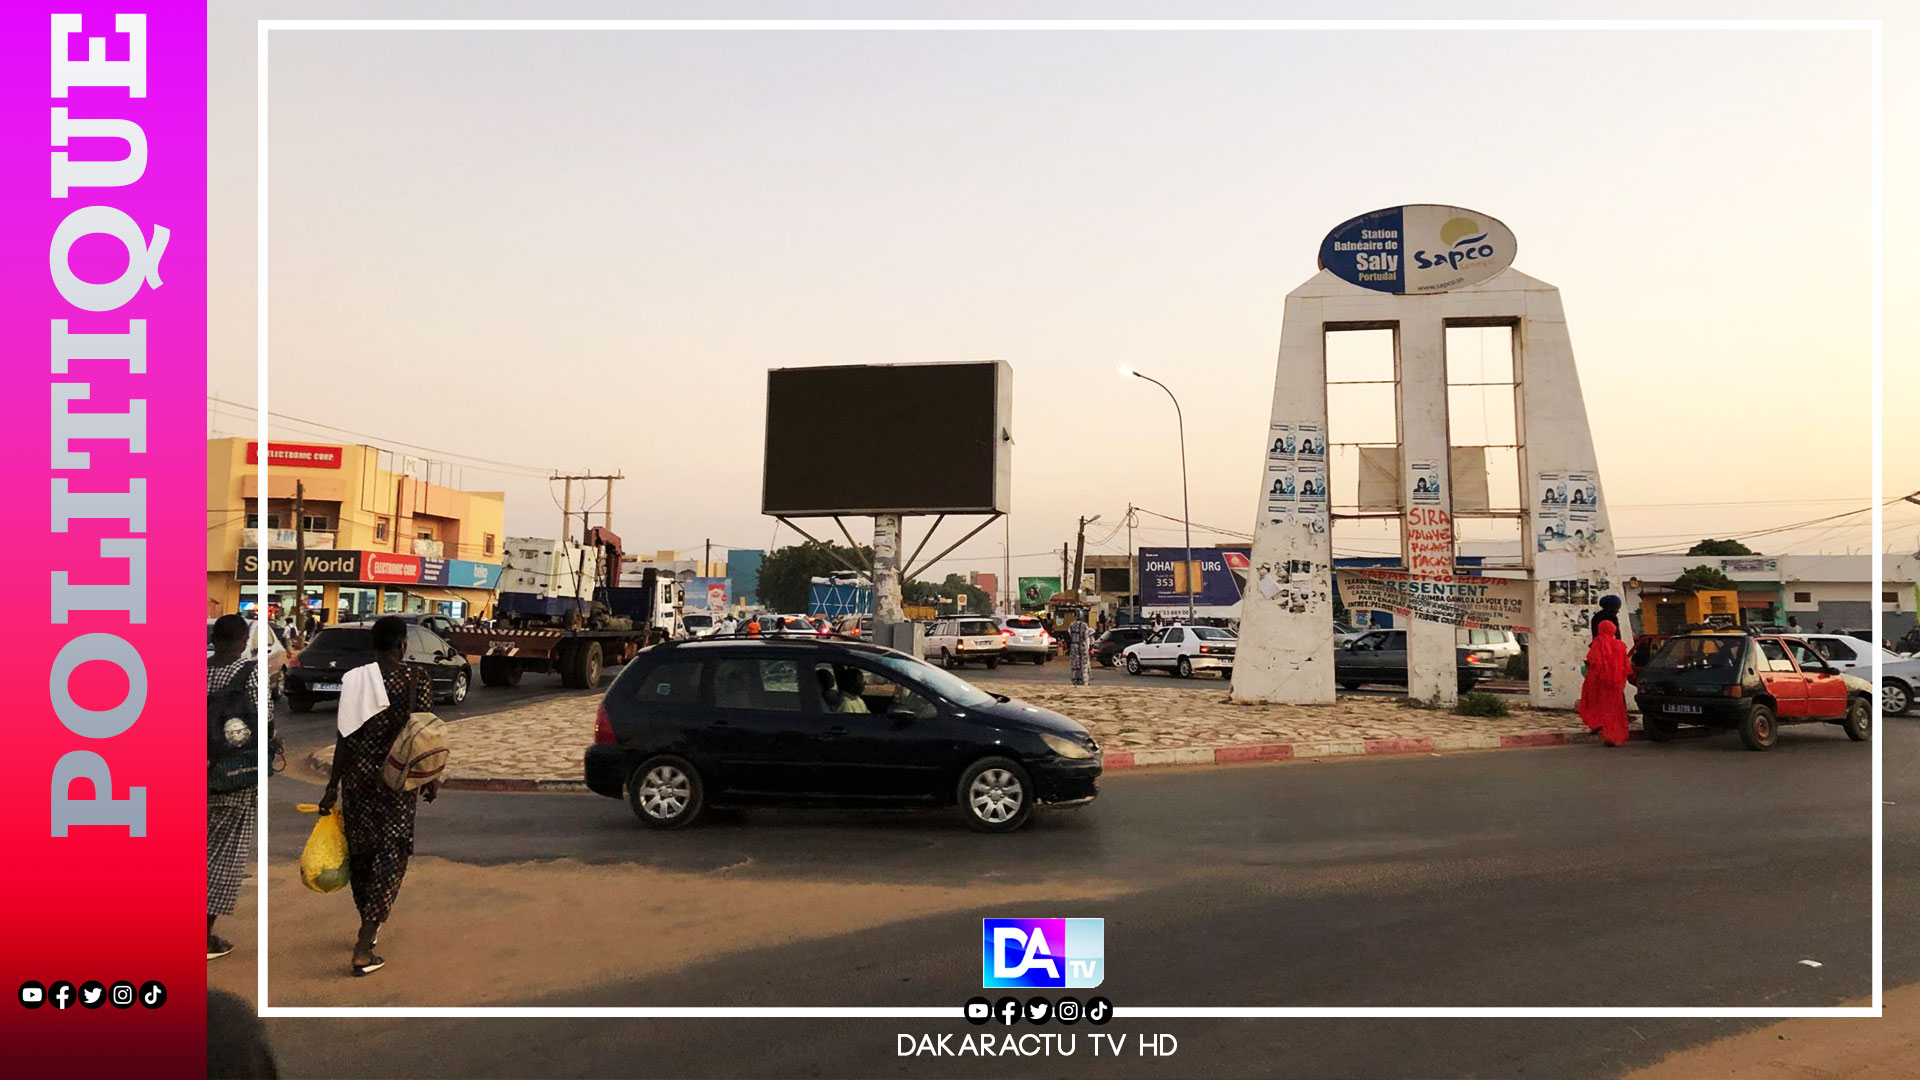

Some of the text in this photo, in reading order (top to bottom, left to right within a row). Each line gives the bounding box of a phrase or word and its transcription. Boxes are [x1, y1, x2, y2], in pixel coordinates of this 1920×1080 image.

[1361, 229, 1398, 239] Station
[1334, 240, 1398, 251] Balnéaire de
[1356, 252, 1398, 272] Saly
[1413, 244, 1494, 270] Sapco
[1359, 271, 1397, 281] Portudal
[1408, 507, 1450, 526] SIRA
[244, 556, 355, 575] Sny World
